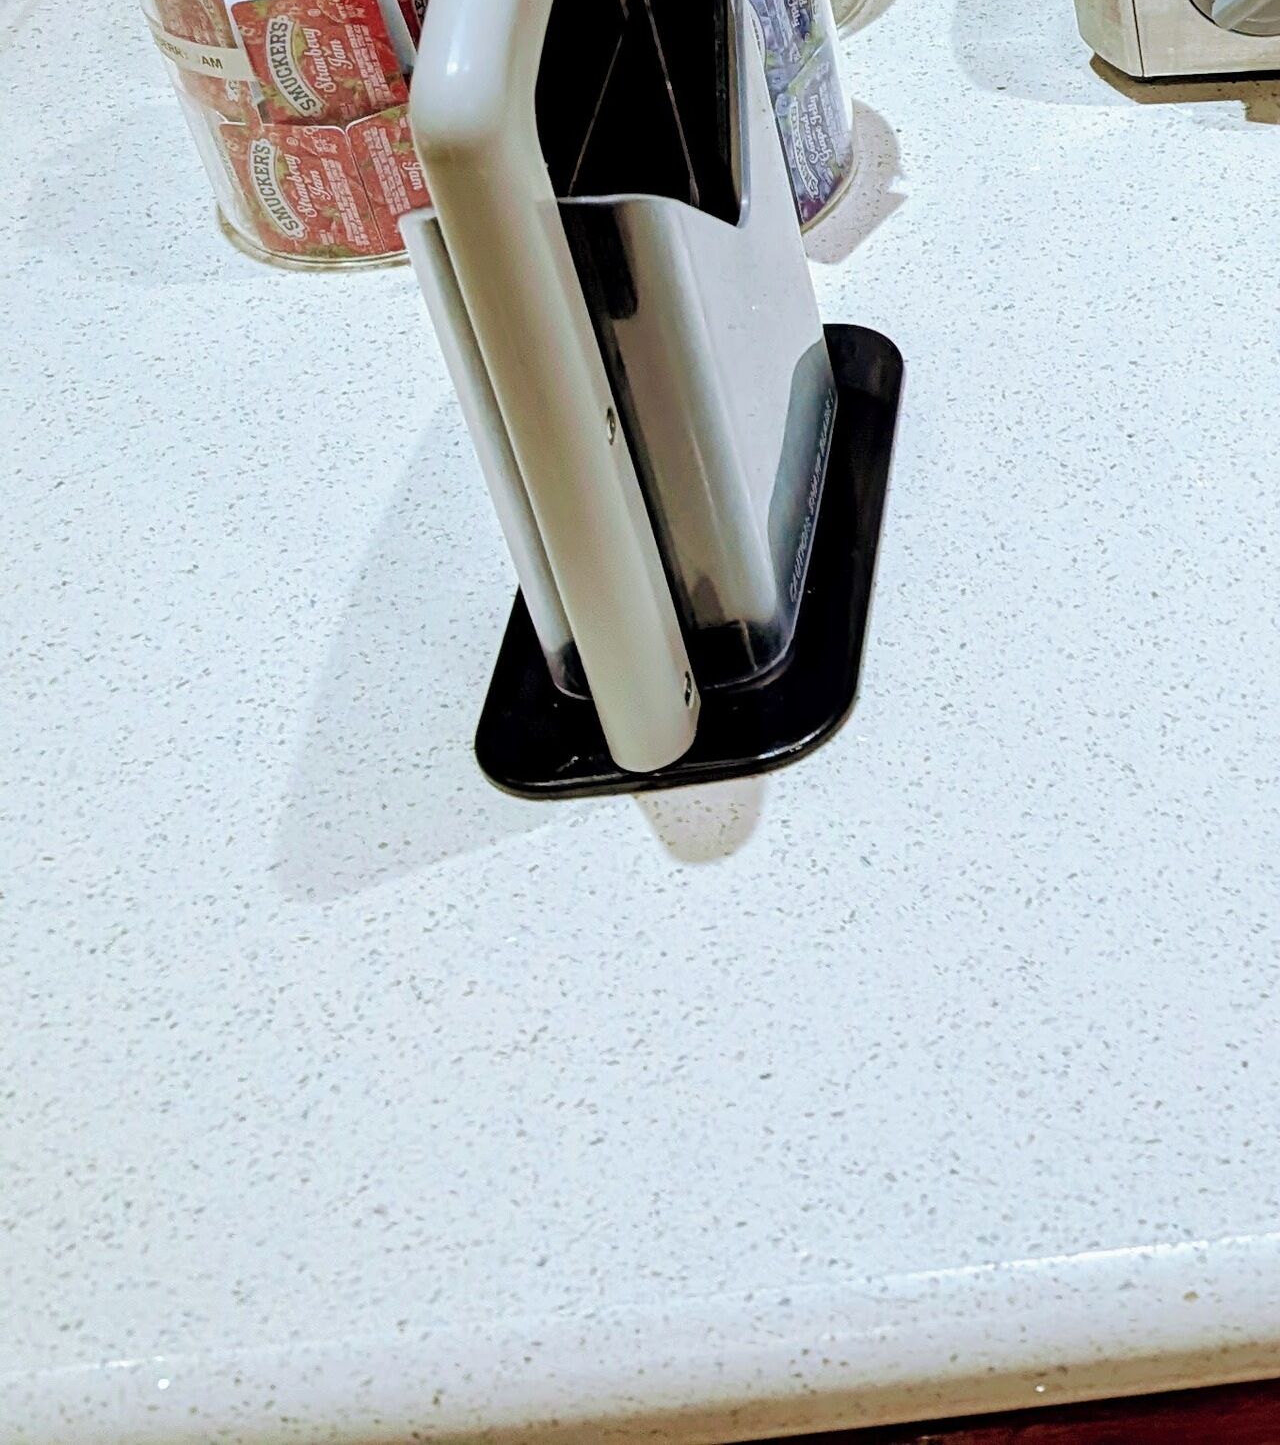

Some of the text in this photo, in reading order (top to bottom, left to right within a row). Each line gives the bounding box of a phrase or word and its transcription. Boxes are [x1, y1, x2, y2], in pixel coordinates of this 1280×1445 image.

[268, 19, 317, 112] SMUCKER'S
[302, 27, 337, 94] Strawberry
[329, 38, 354, 70] Jam
[253, 143, 300, 233] SMUCKER'S
[284, 153, 318, 218] Strawberry
[307, 169, 333, 202] Jam
